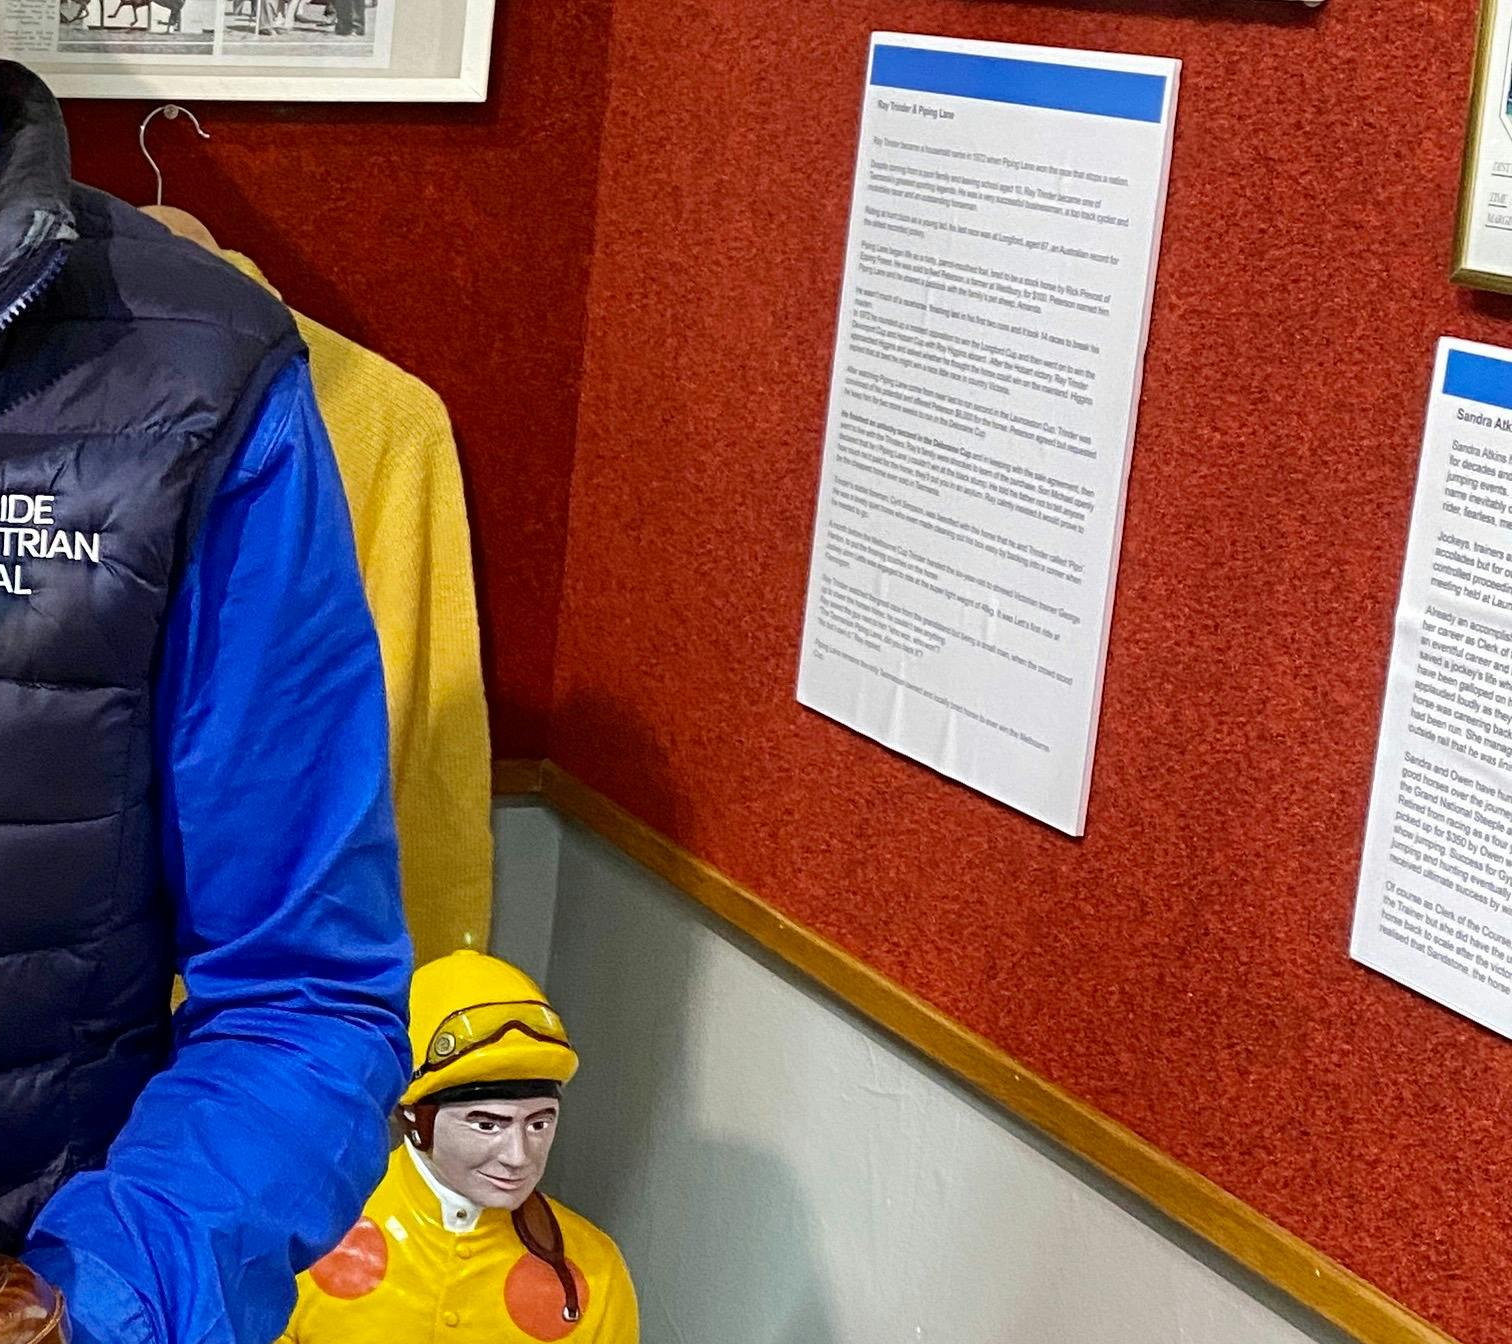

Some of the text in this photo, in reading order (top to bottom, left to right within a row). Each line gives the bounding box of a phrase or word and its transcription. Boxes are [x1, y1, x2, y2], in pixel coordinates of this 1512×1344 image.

[878, 99, 890, 113] Ray
[919, 105, 938, 120] Piping
[939, 108, 955, 120] Lane
[1457, 408, 1512, 432] Sandra Atk
[1452, 439, 1507, 463] Sandra Atkins
[1449, 455, 1496, 476] for decades
